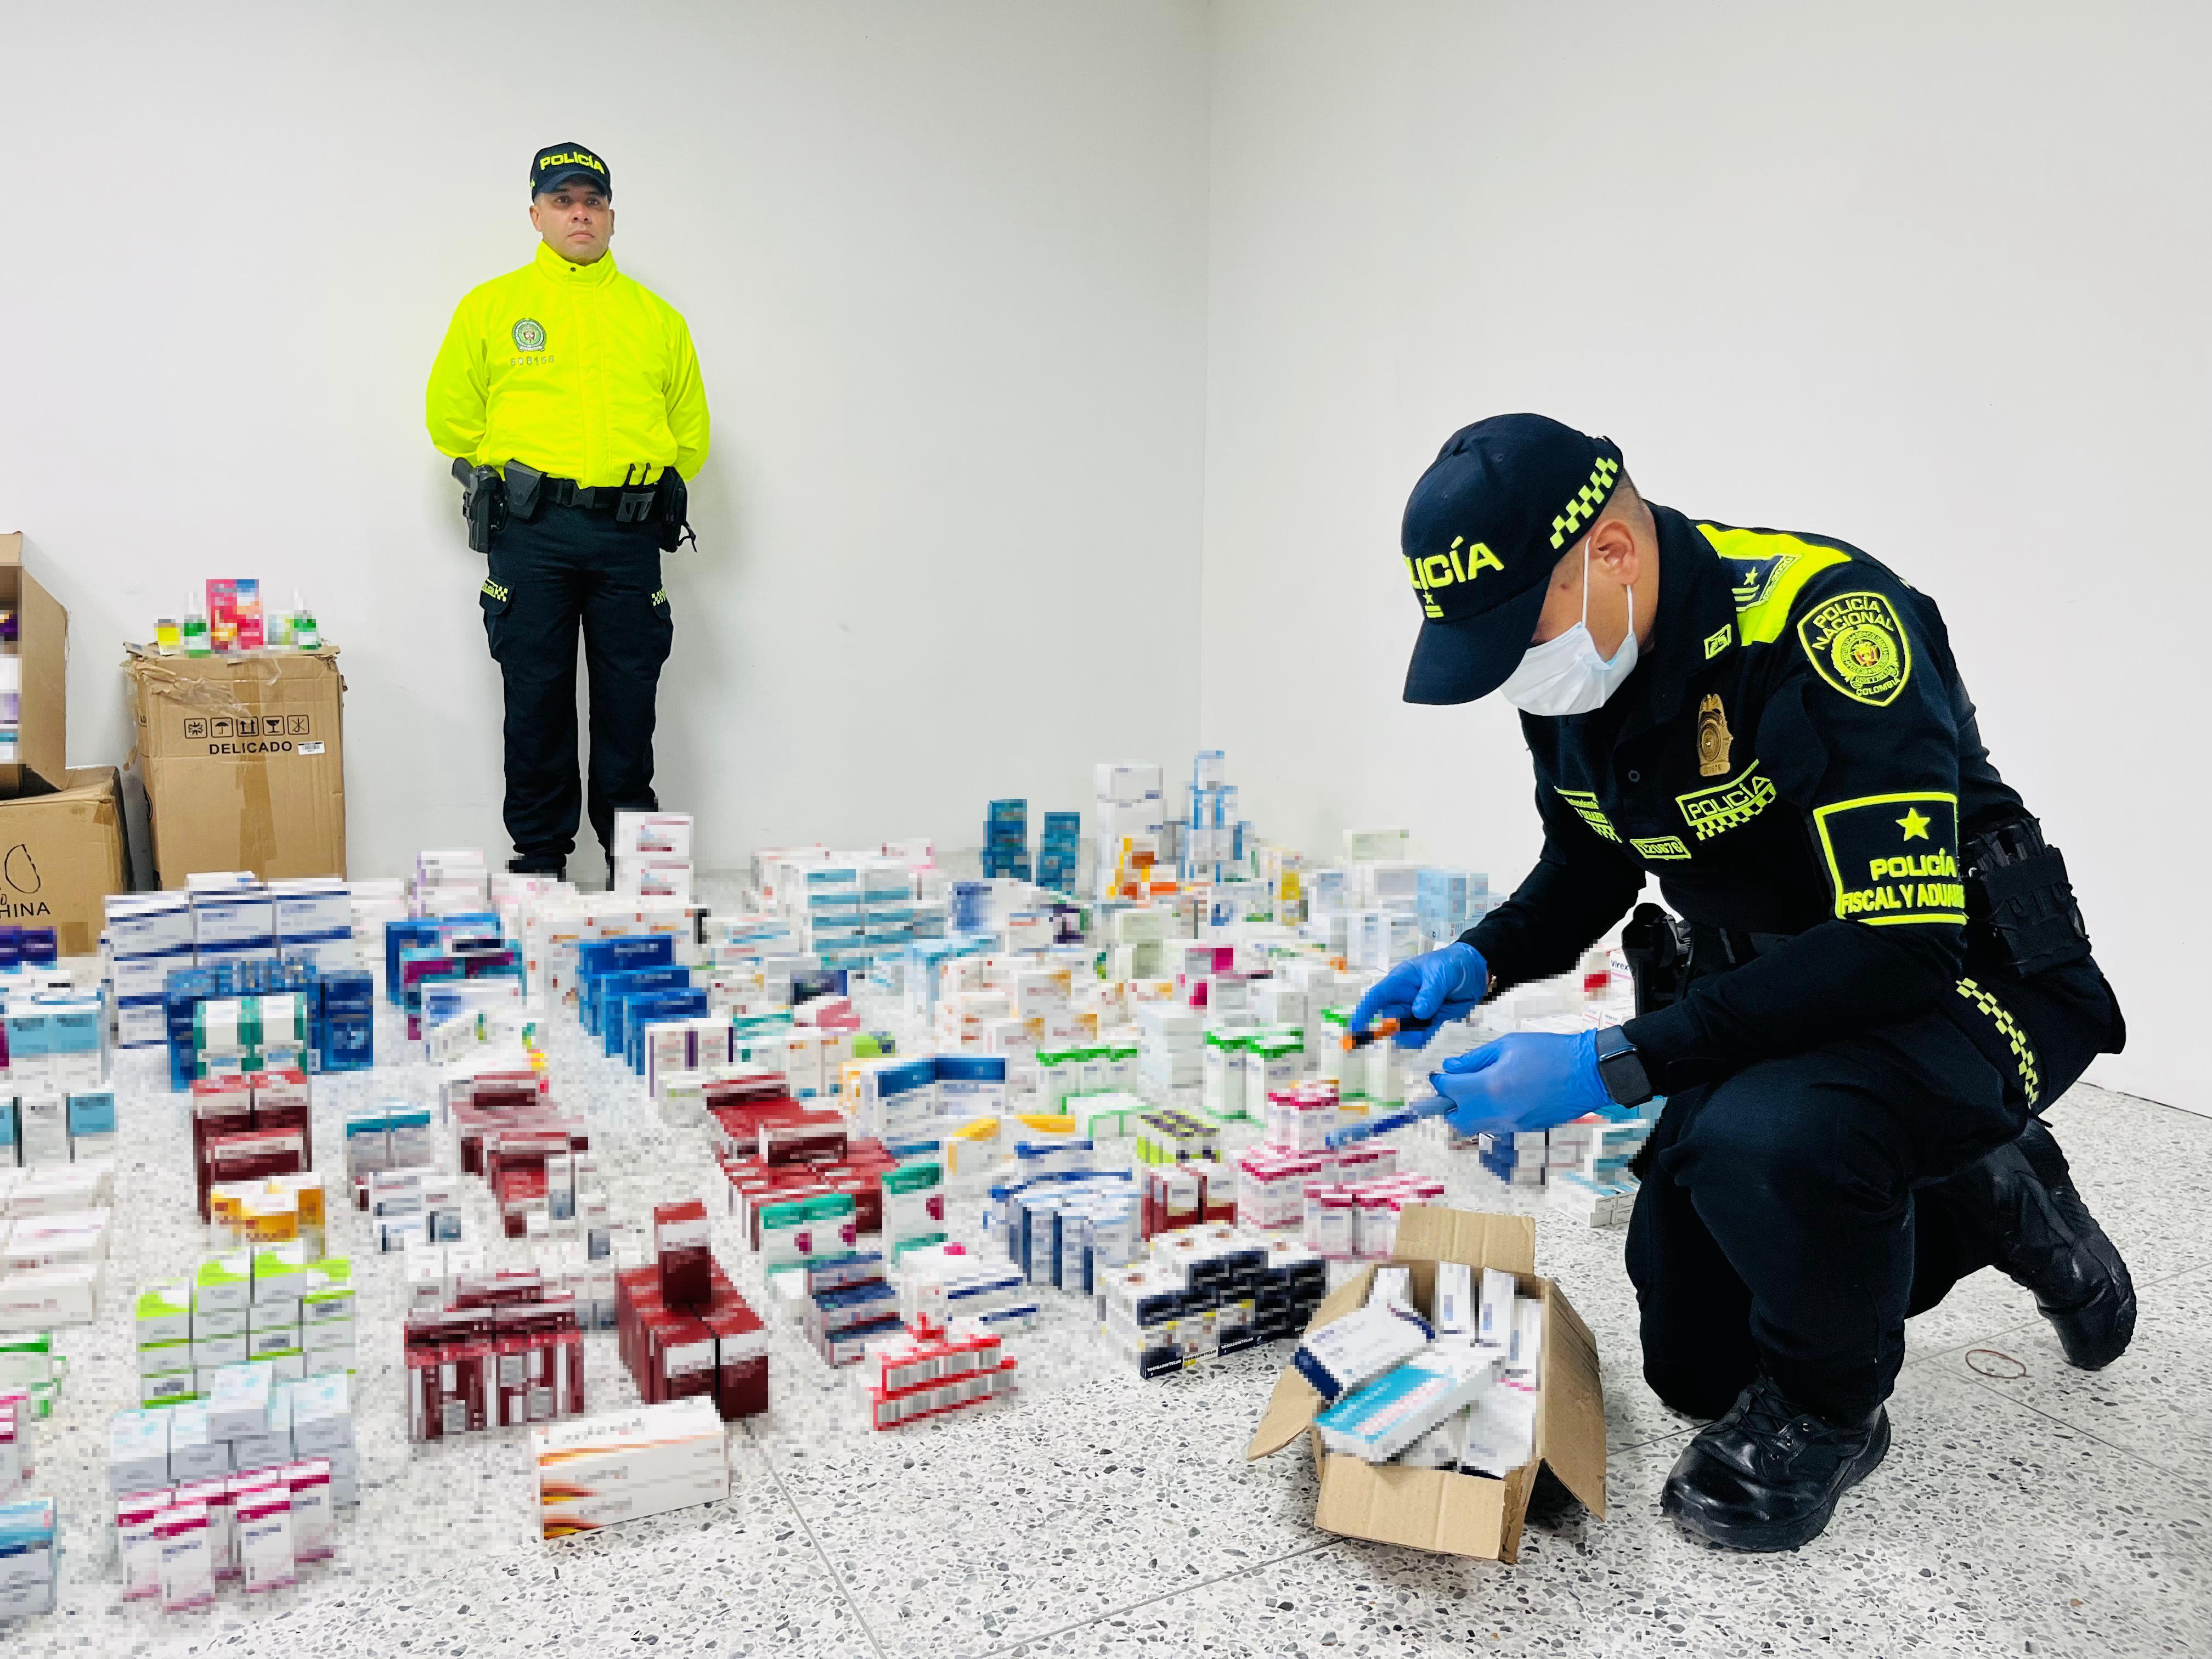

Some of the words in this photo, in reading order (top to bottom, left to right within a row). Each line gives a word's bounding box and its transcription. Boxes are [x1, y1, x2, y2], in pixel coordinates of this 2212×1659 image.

[540, 151, 605, 175] POLICÍA
[1403, 535, 1505, 590] LICÍA
[1813, 596, 1881, 629] POLICÍA
[1812, 611, 1894, 651] NACIONAL
[1856, 676, 1900, 696] COLOMBIA
[210, 741, 292, 755] DELICADO
[1687, 776, 1771, 820] POLICÍA
[1869, 847, 1957, 881] POLICÍA
[0, 901, 51, 919] HINA
[1842, 885, 1902, 915] FISCAL
[1899, 884, 1914, 909] Y
